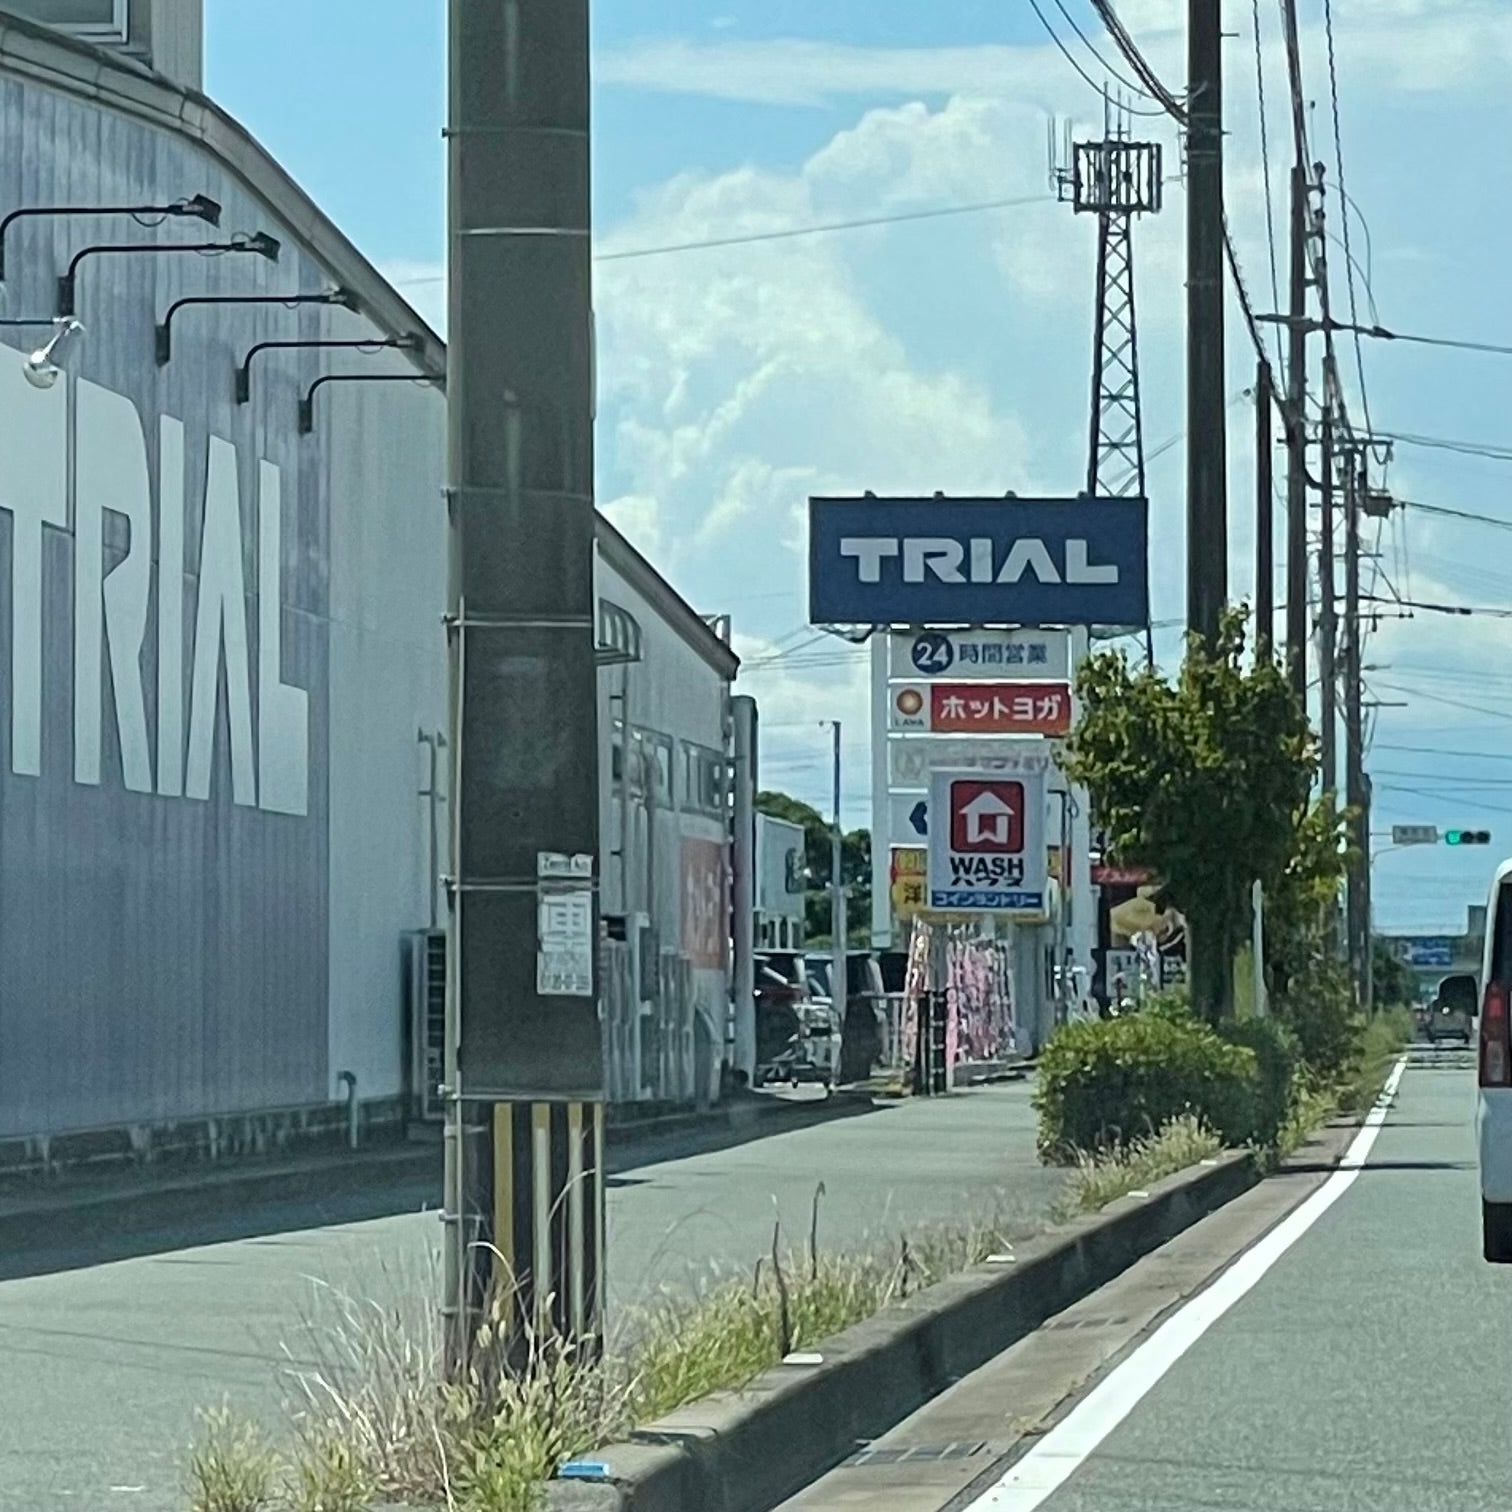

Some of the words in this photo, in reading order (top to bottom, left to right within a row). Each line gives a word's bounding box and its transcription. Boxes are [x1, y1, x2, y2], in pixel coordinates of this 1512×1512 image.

[840, 537, 1120, 585] TRIAL
[916, 641, 1049, 666] 24時間営業
[940, 694, 1063, 720] ホットヨガ
[950, 856, 1025, 877] WASH
[935, 892, 1040, 907] コインランドリー
